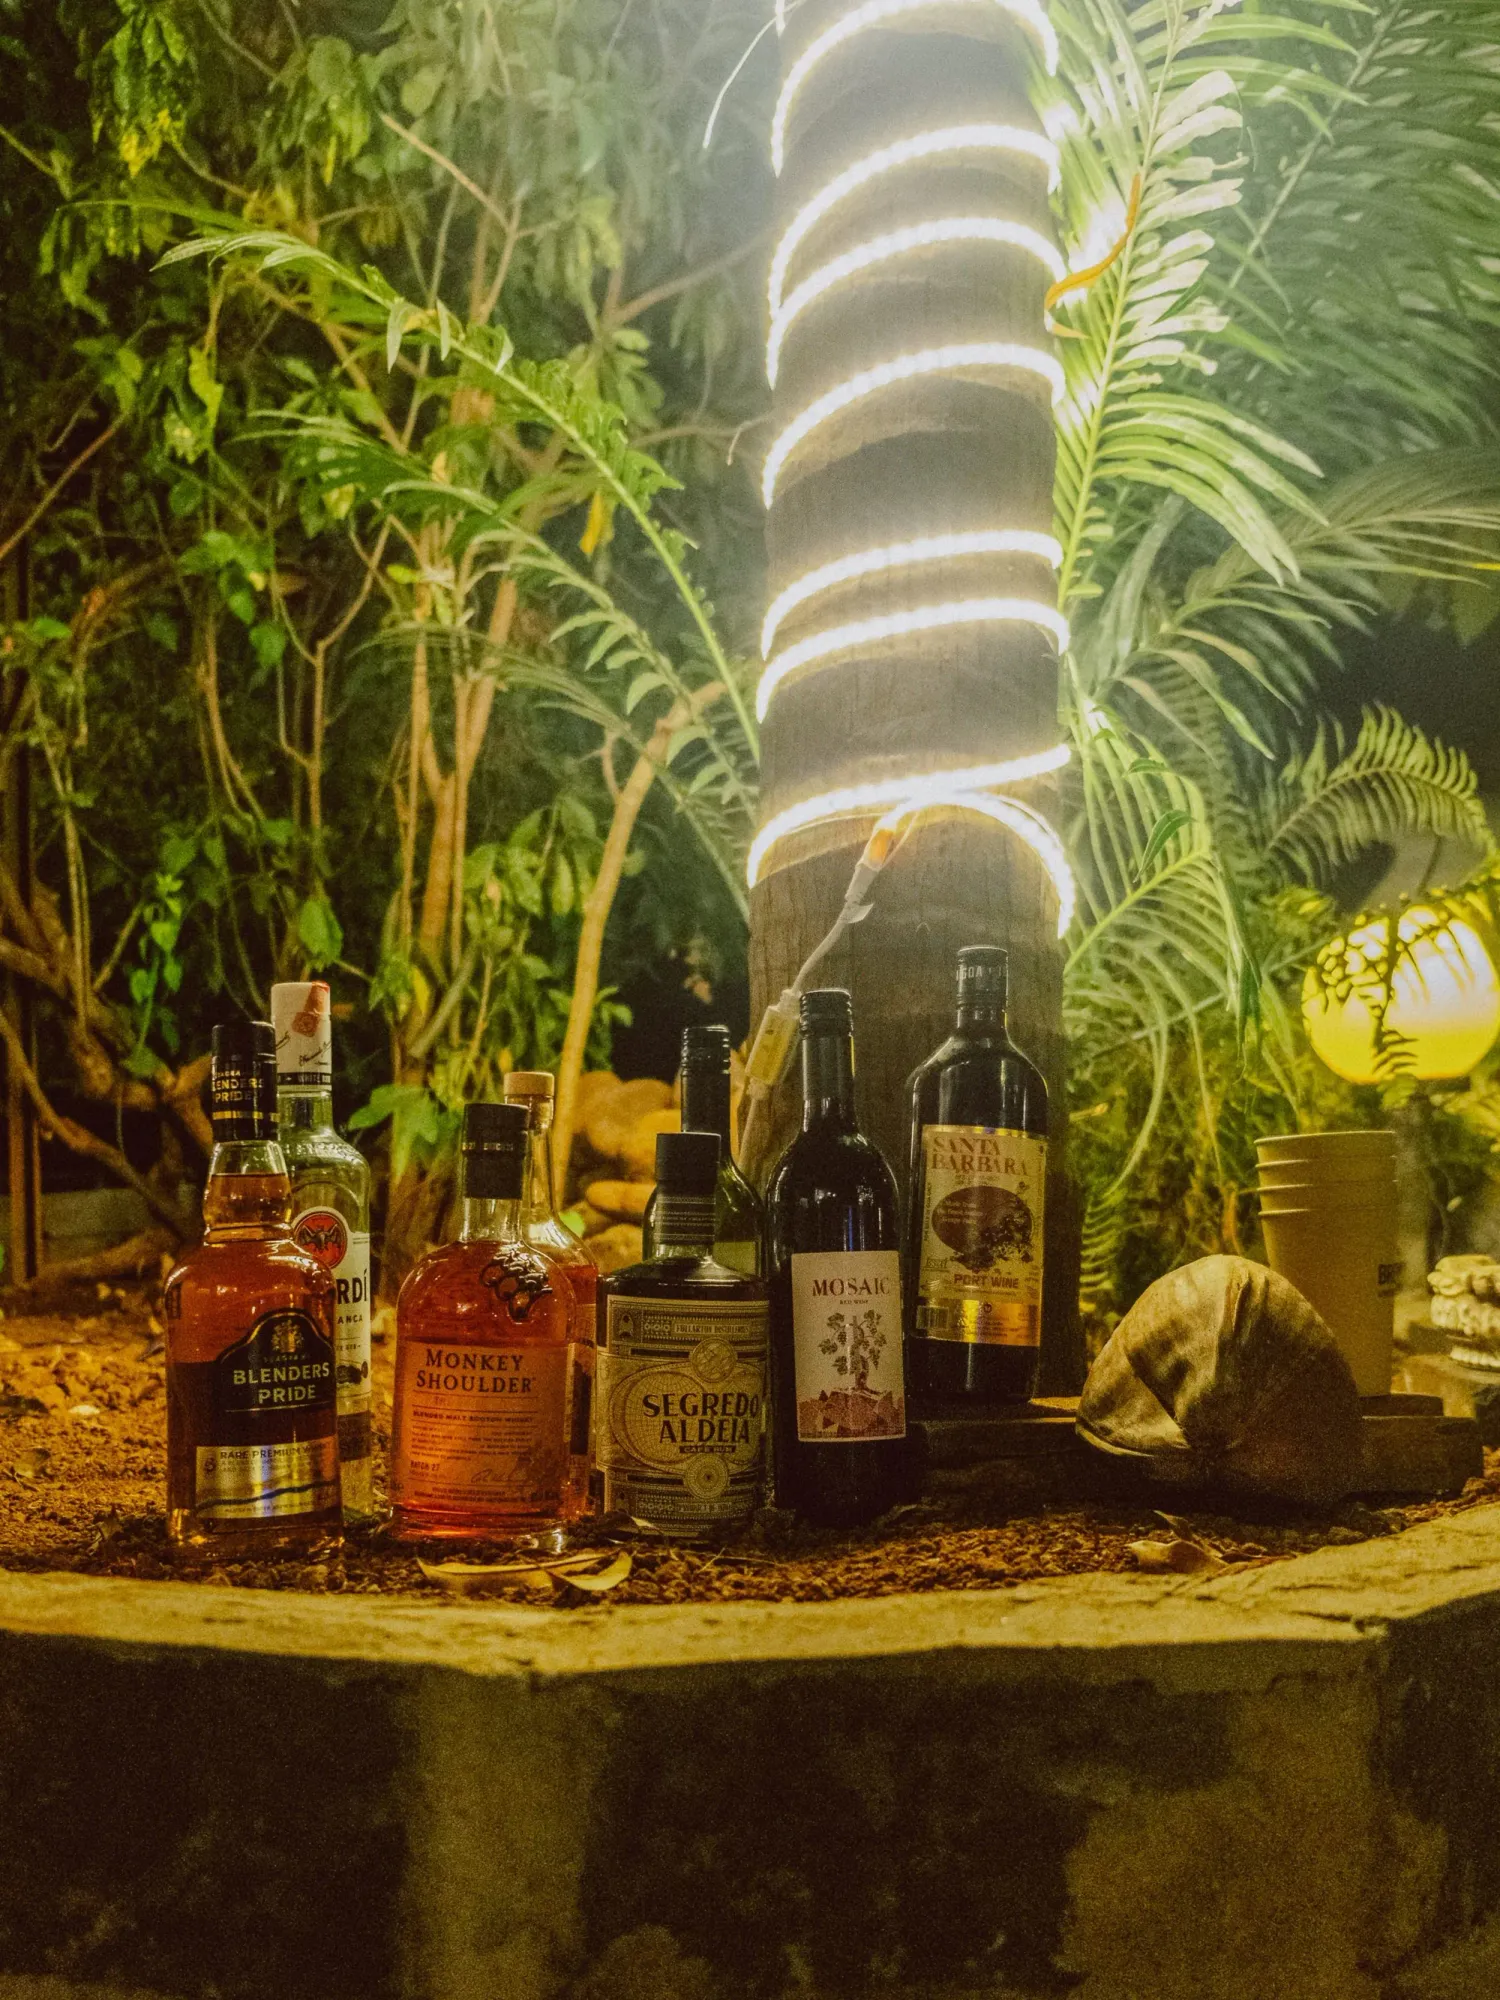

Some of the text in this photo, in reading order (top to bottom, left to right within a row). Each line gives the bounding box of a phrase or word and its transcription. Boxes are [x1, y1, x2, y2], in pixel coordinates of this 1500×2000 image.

[932, 1136, 1002, 1156] SANTA
[931, 1153, 1029, 1177] BARBARA
[812, 1277, 890, 1297] MOSAIC
[953, 1273, 988, 1287] PORT
[991, 1276, 1019, 1289] WINE
[425, 1348, 523, 1372] MONKEY
[233, 1362, 330, 1385] BLENDERS
[416, 1370, 532, 1394] SHOULDER
[258, 1384, 316, 1404] PRIDE
[642, 1392, 759, 1419] SEGREDO
[659, 1419, 750, 1444] ALDEIA
